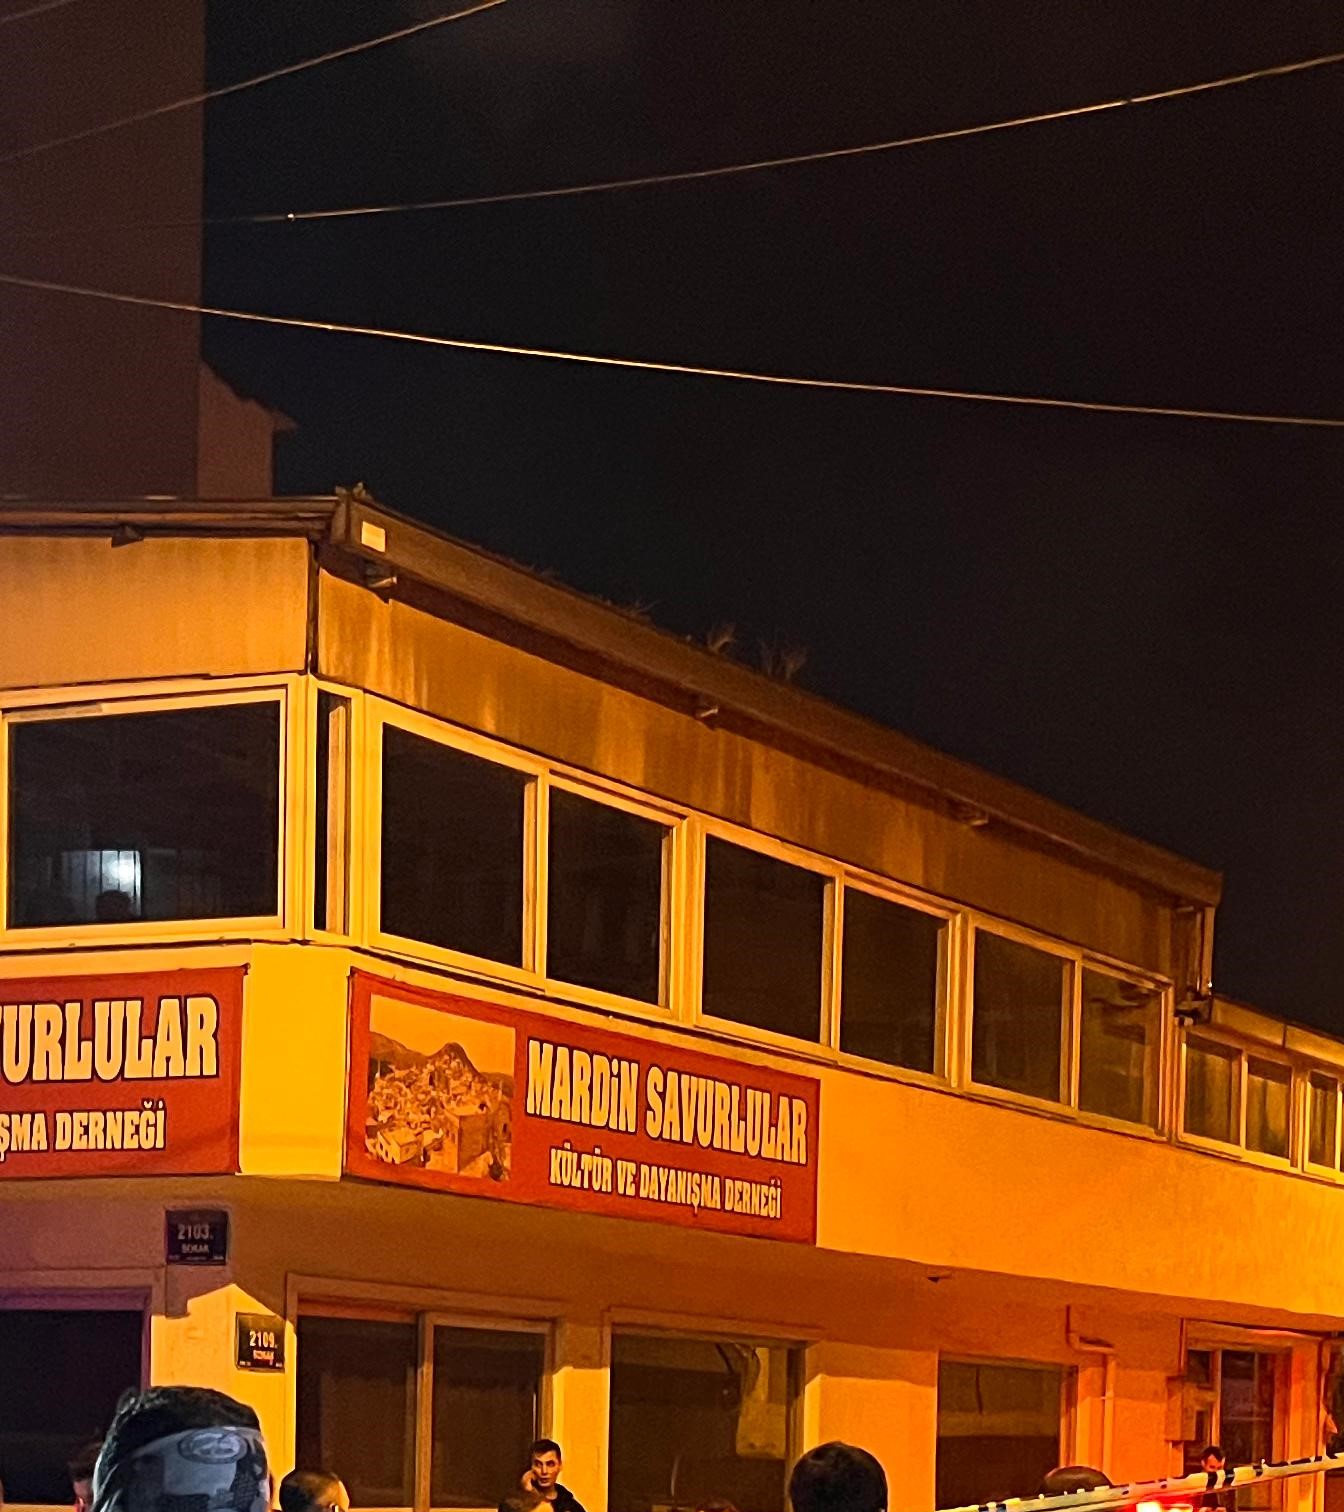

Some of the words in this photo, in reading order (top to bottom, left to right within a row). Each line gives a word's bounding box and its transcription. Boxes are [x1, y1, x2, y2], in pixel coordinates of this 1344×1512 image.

[55, 1100, 166, 1150] DERNEĞİ
[645, 1065, 808, 1166] SAVURLULAR
[549, 1141, 613, 1194] KÜLTÜR
[616, 1159, 638, 1197] VE
[639, 1163, 722, 1215] DAYANIŞMA
[723, 1176, 782, 1219] DERNEĞİ
